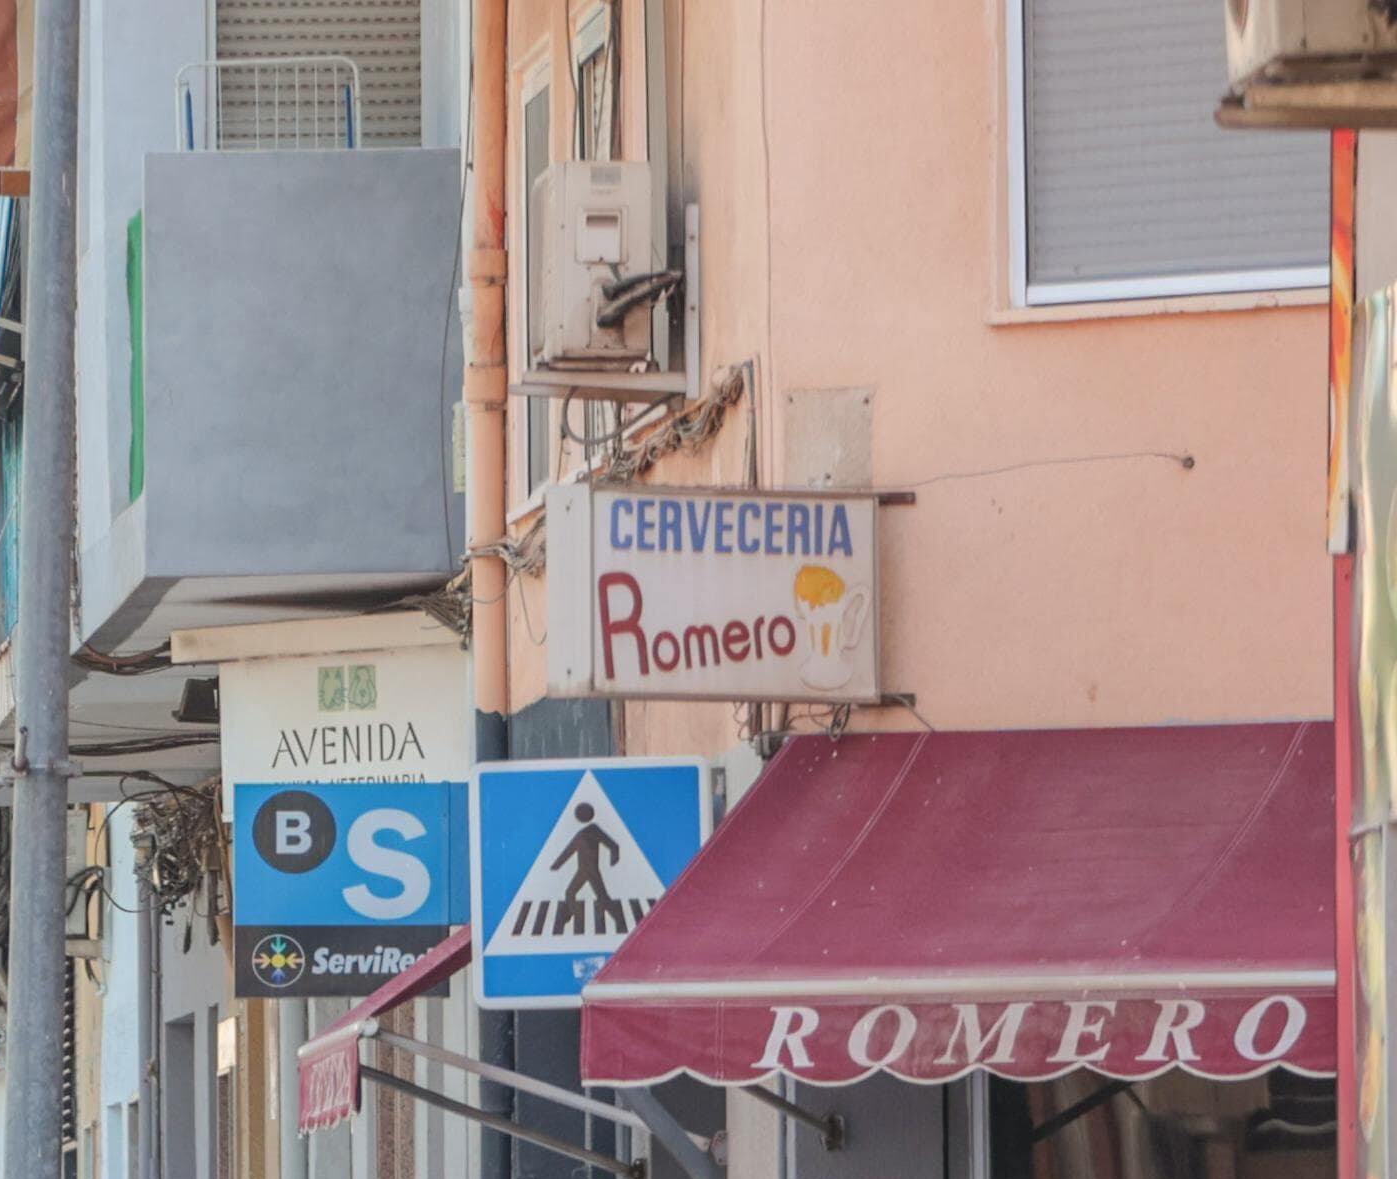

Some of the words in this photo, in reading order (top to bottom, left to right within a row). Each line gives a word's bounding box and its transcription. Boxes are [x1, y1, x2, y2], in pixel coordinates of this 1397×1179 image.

[609, 499, 853, 557] CERVECERIA
[598, 571, 797, 680] Romero
[271, 721, 426, 769] AVENIDA
[275, 810, 313, 855] B
[341, 807, 431, 920] S
[311, 945, 434, 975] ServiRe
[751, 995, 1307, 1070] ROMERO
